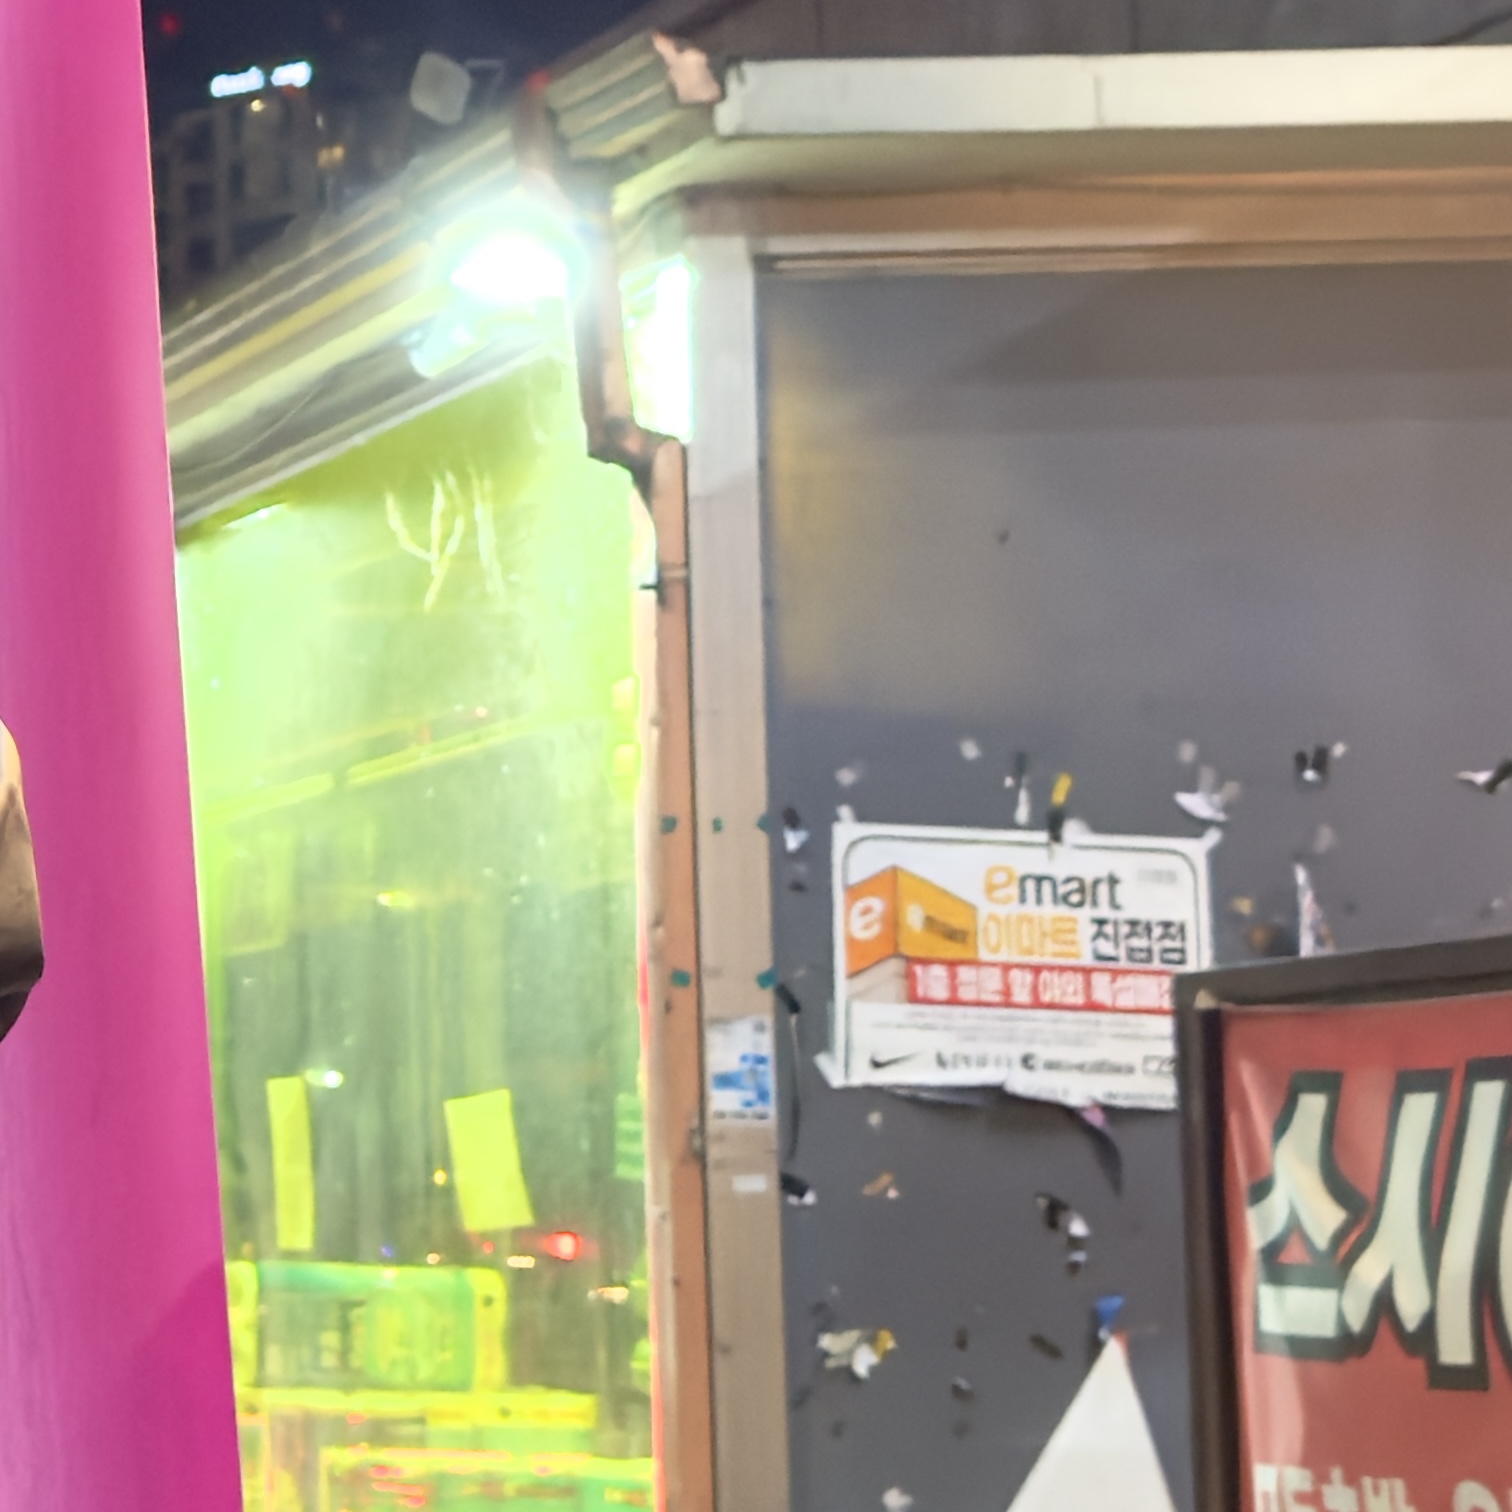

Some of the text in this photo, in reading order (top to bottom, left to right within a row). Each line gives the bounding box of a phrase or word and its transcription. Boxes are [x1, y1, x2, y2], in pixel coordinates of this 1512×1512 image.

[983, 863, 1123, 911] emart
[982, 912, 1084, 960] 이마트
[1089, 916, 1188, 966] 진접점
[1242, 1055, 1512, 1391] 스시
